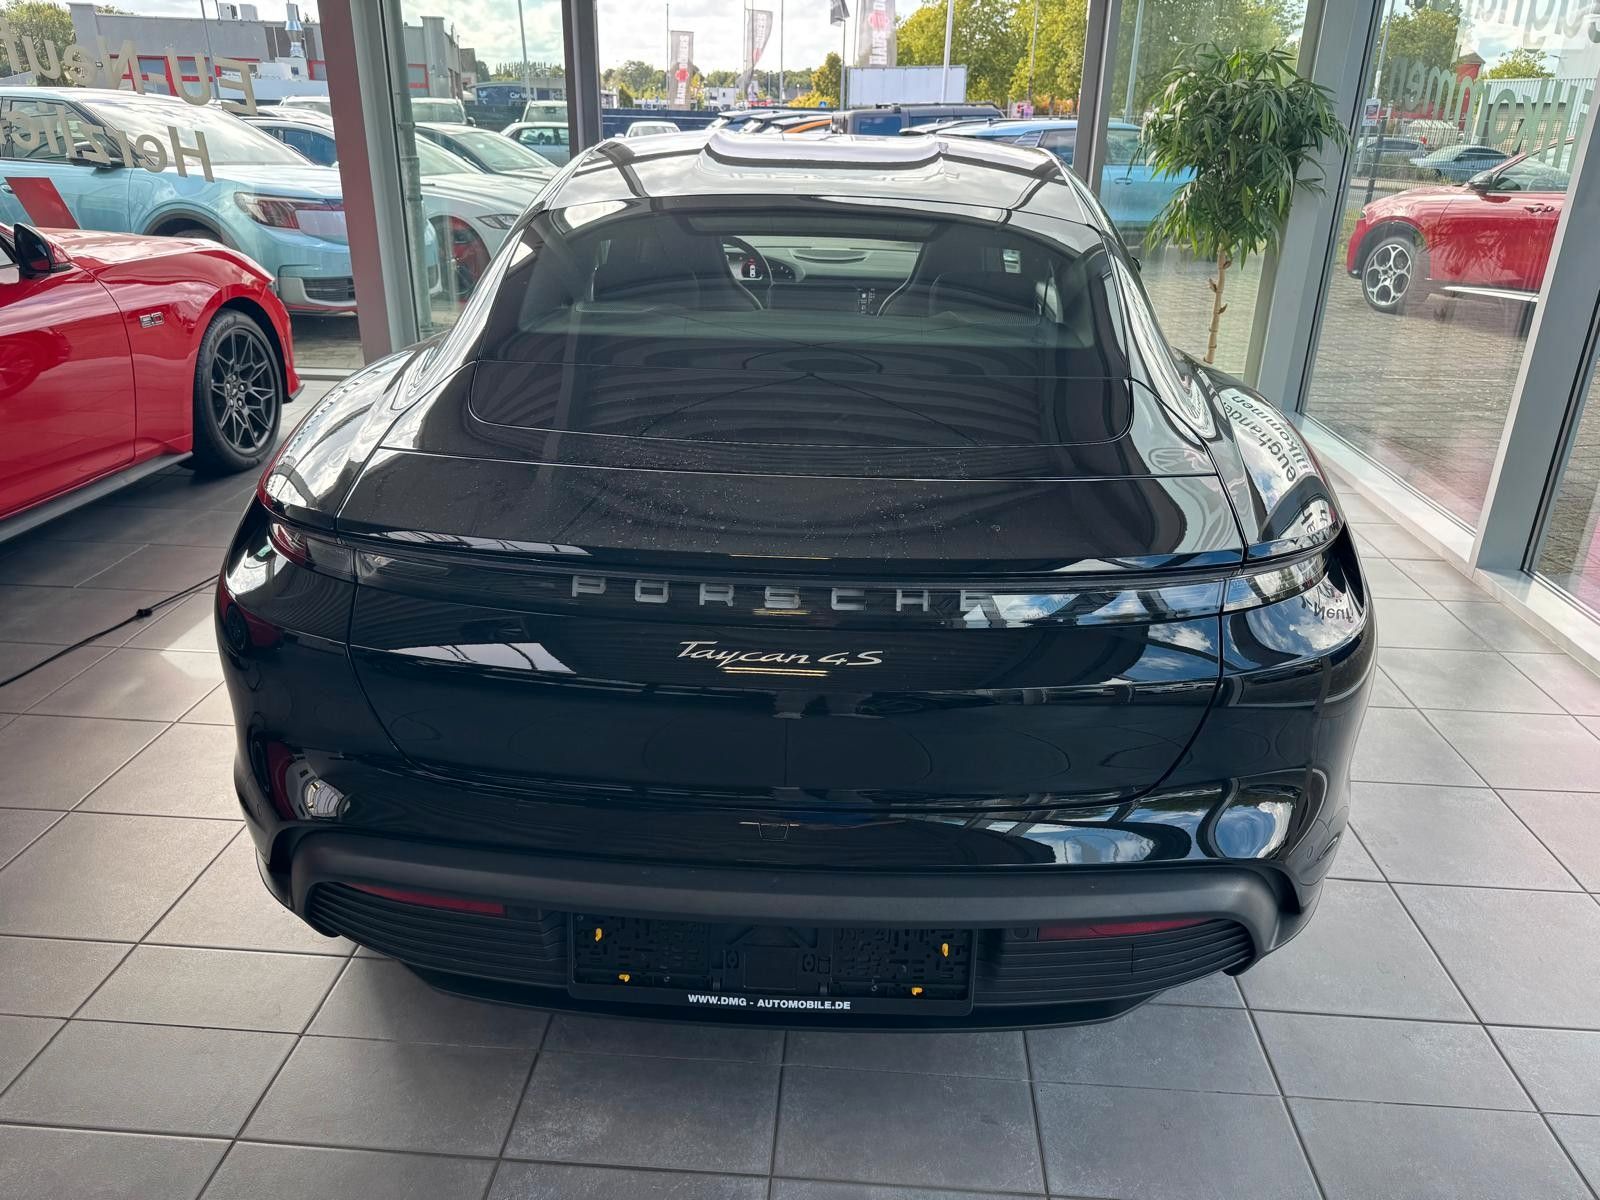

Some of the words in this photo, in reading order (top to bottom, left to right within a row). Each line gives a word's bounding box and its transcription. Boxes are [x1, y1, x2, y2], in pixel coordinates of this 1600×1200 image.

[571, 575, 993, 613] PORSCHE
[676, 641, 810, 668] Taycan
[817, 650, 884, 666] 4S
[688, 994, 747, 1007] WWW.DMG
[757, 998, 851, 1010] AUTOMOBILE.DE
